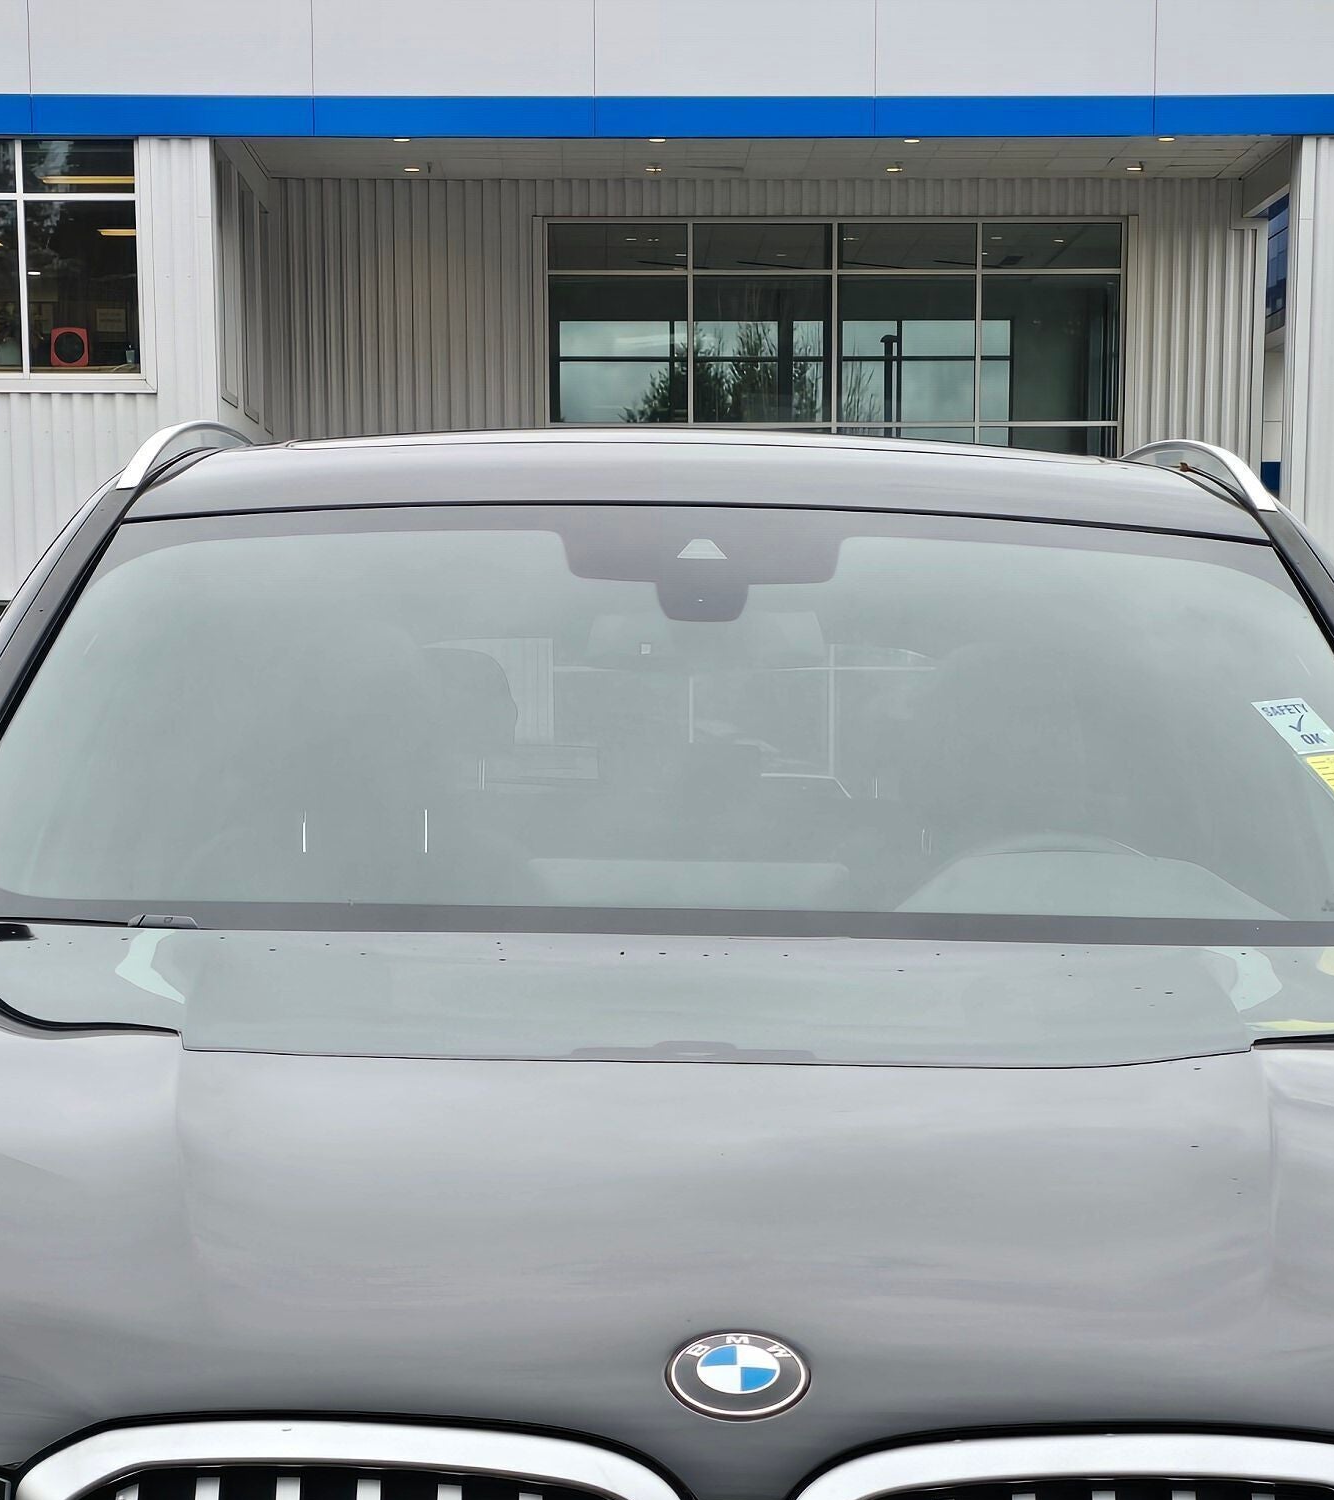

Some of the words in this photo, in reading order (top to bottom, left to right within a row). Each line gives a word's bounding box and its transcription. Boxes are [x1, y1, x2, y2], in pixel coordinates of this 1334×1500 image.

[1261, 703, 1309, 717] SAFETY
[1301, 733, 1327, 745] OK
[685, 1335, 792, 1358] BMW
